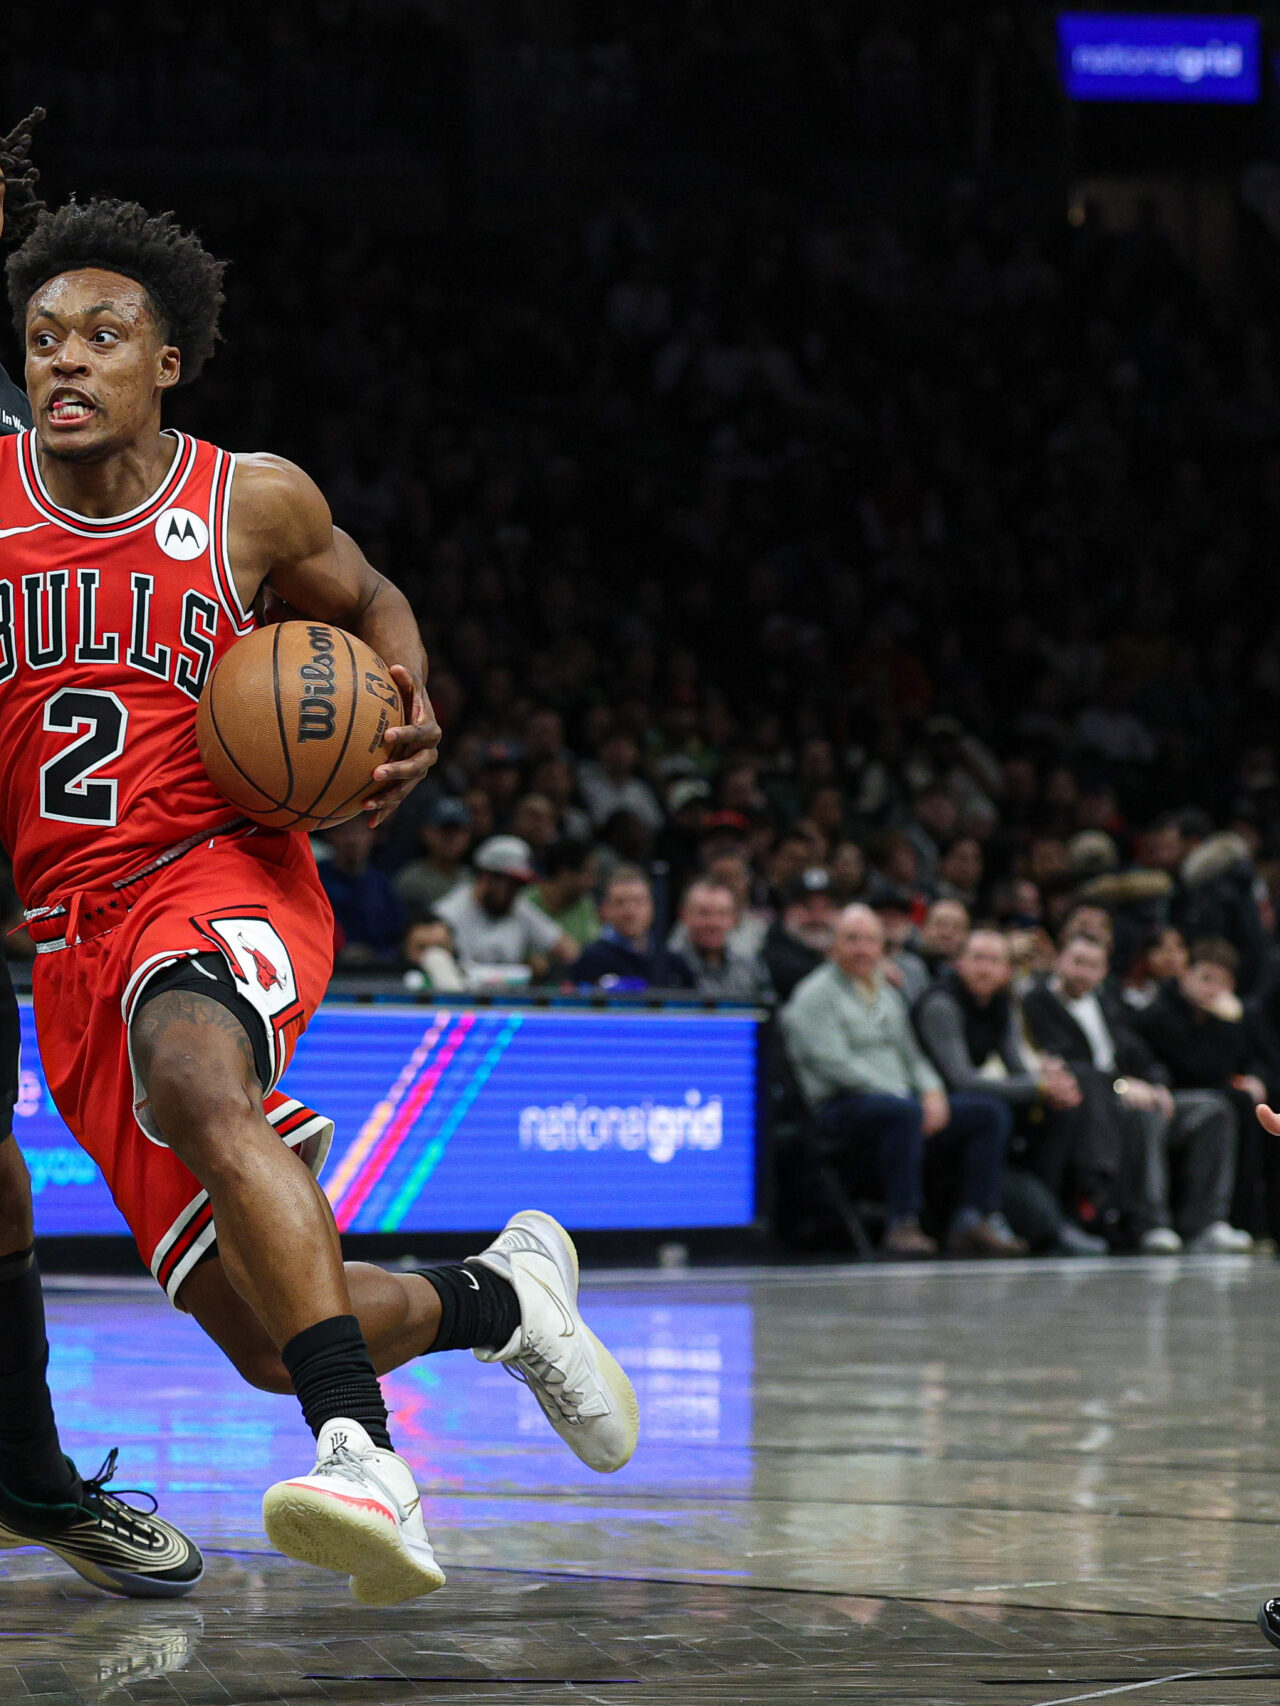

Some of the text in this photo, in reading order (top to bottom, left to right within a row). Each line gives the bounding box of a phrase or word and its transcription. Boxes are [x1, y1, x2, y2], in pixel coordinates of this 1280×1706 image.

[2, 410, 12, 425] In
[297, 625, 337, 744] Wilson
[38, 686, 130, 828] 2
[518, 1088, 724, 1165] nationalgrid
